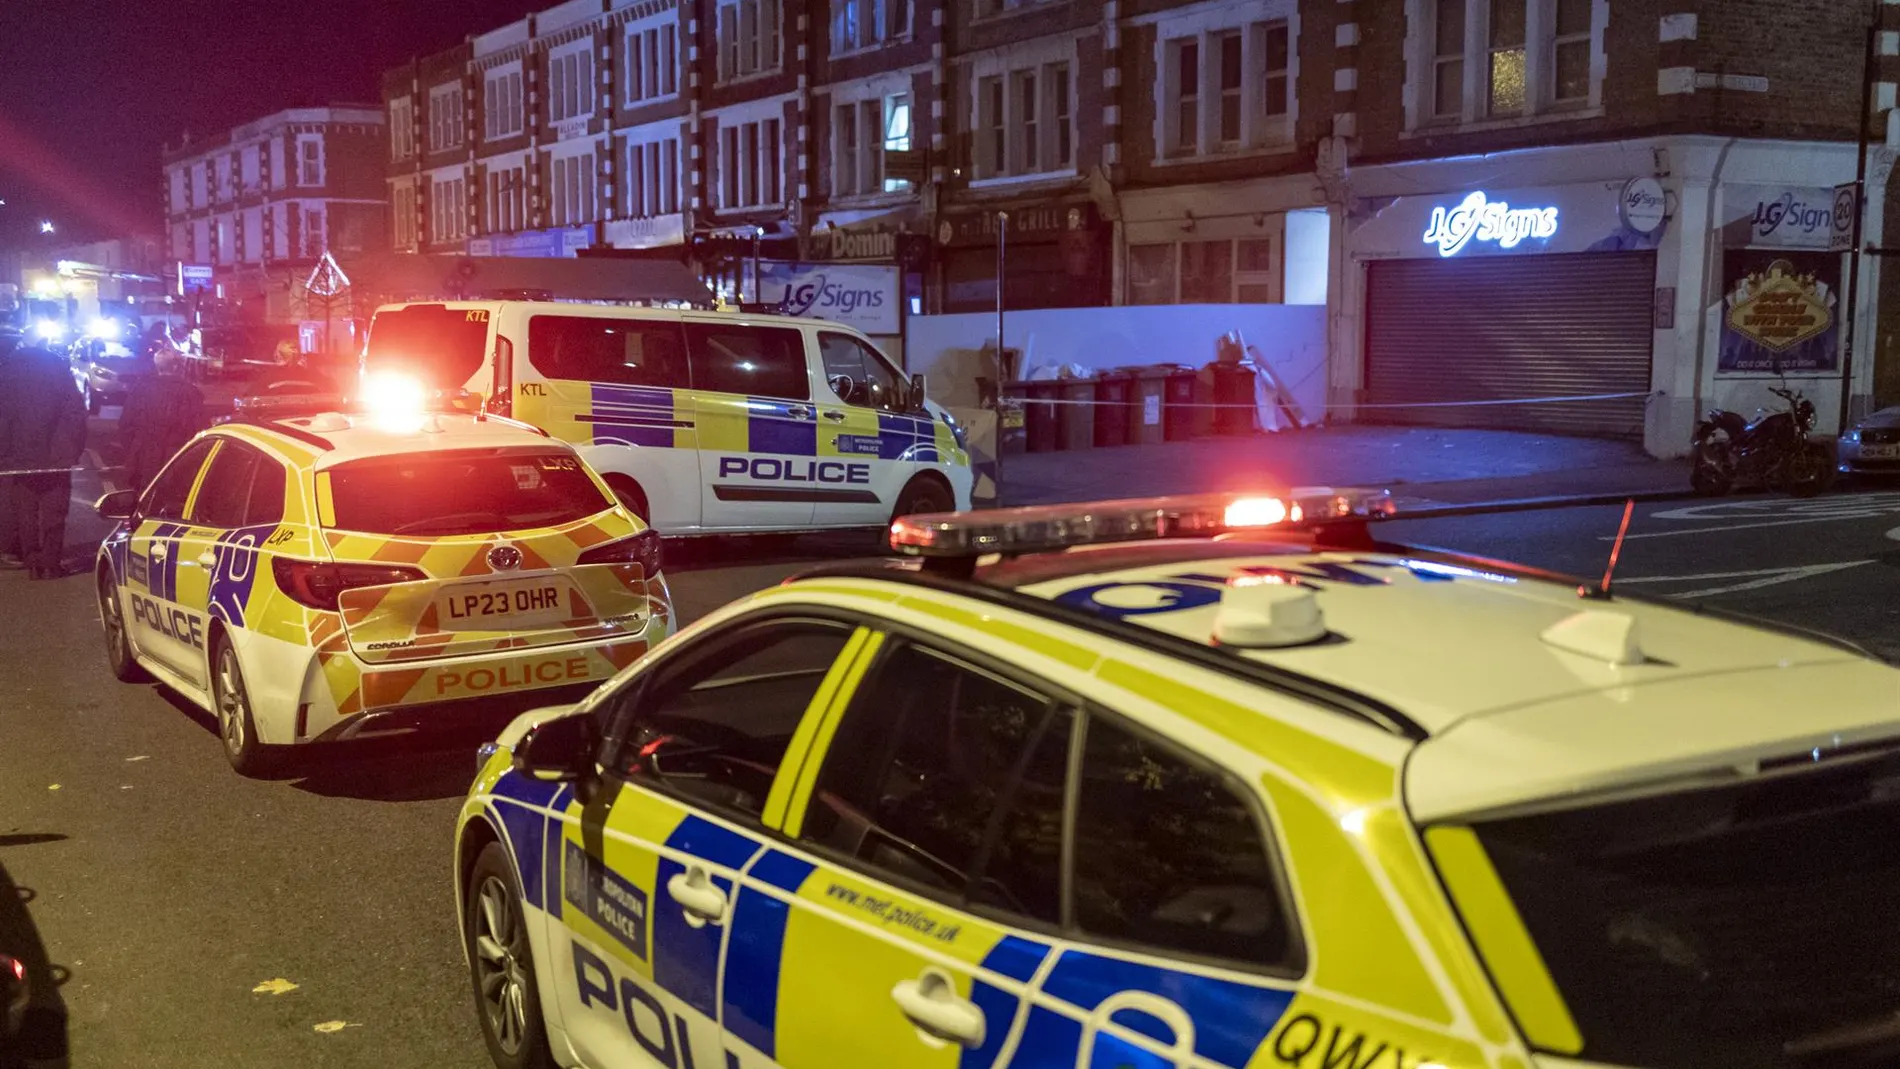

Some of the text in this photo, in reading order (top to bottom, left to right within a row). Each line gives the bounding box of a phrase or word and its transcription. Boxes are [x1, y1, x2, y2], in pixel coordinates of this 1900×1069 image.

[1017, 209, 1059, 232] GRILL
[1477, 202, 1558, 248] Signs
[1788, 202, 1832, 232] Sign
[1837, 202, 1851, 220] 20
[1832, 235, 1851, 246] ZONE
[821, 284, 884, 313] Signs
[465, 310, 489, 322] KTL
[520, 383, 547, 396] KTL
[718, 456, 870, 484] POLICE
[267, 528, 294, 545] LXP
[449, 587, 559, 618] LP23 OHR
[130, 592, 204, 651] POLICE
[436, 657, 590, 695] POLICE
[597, 896, 636, 941] POLICE
